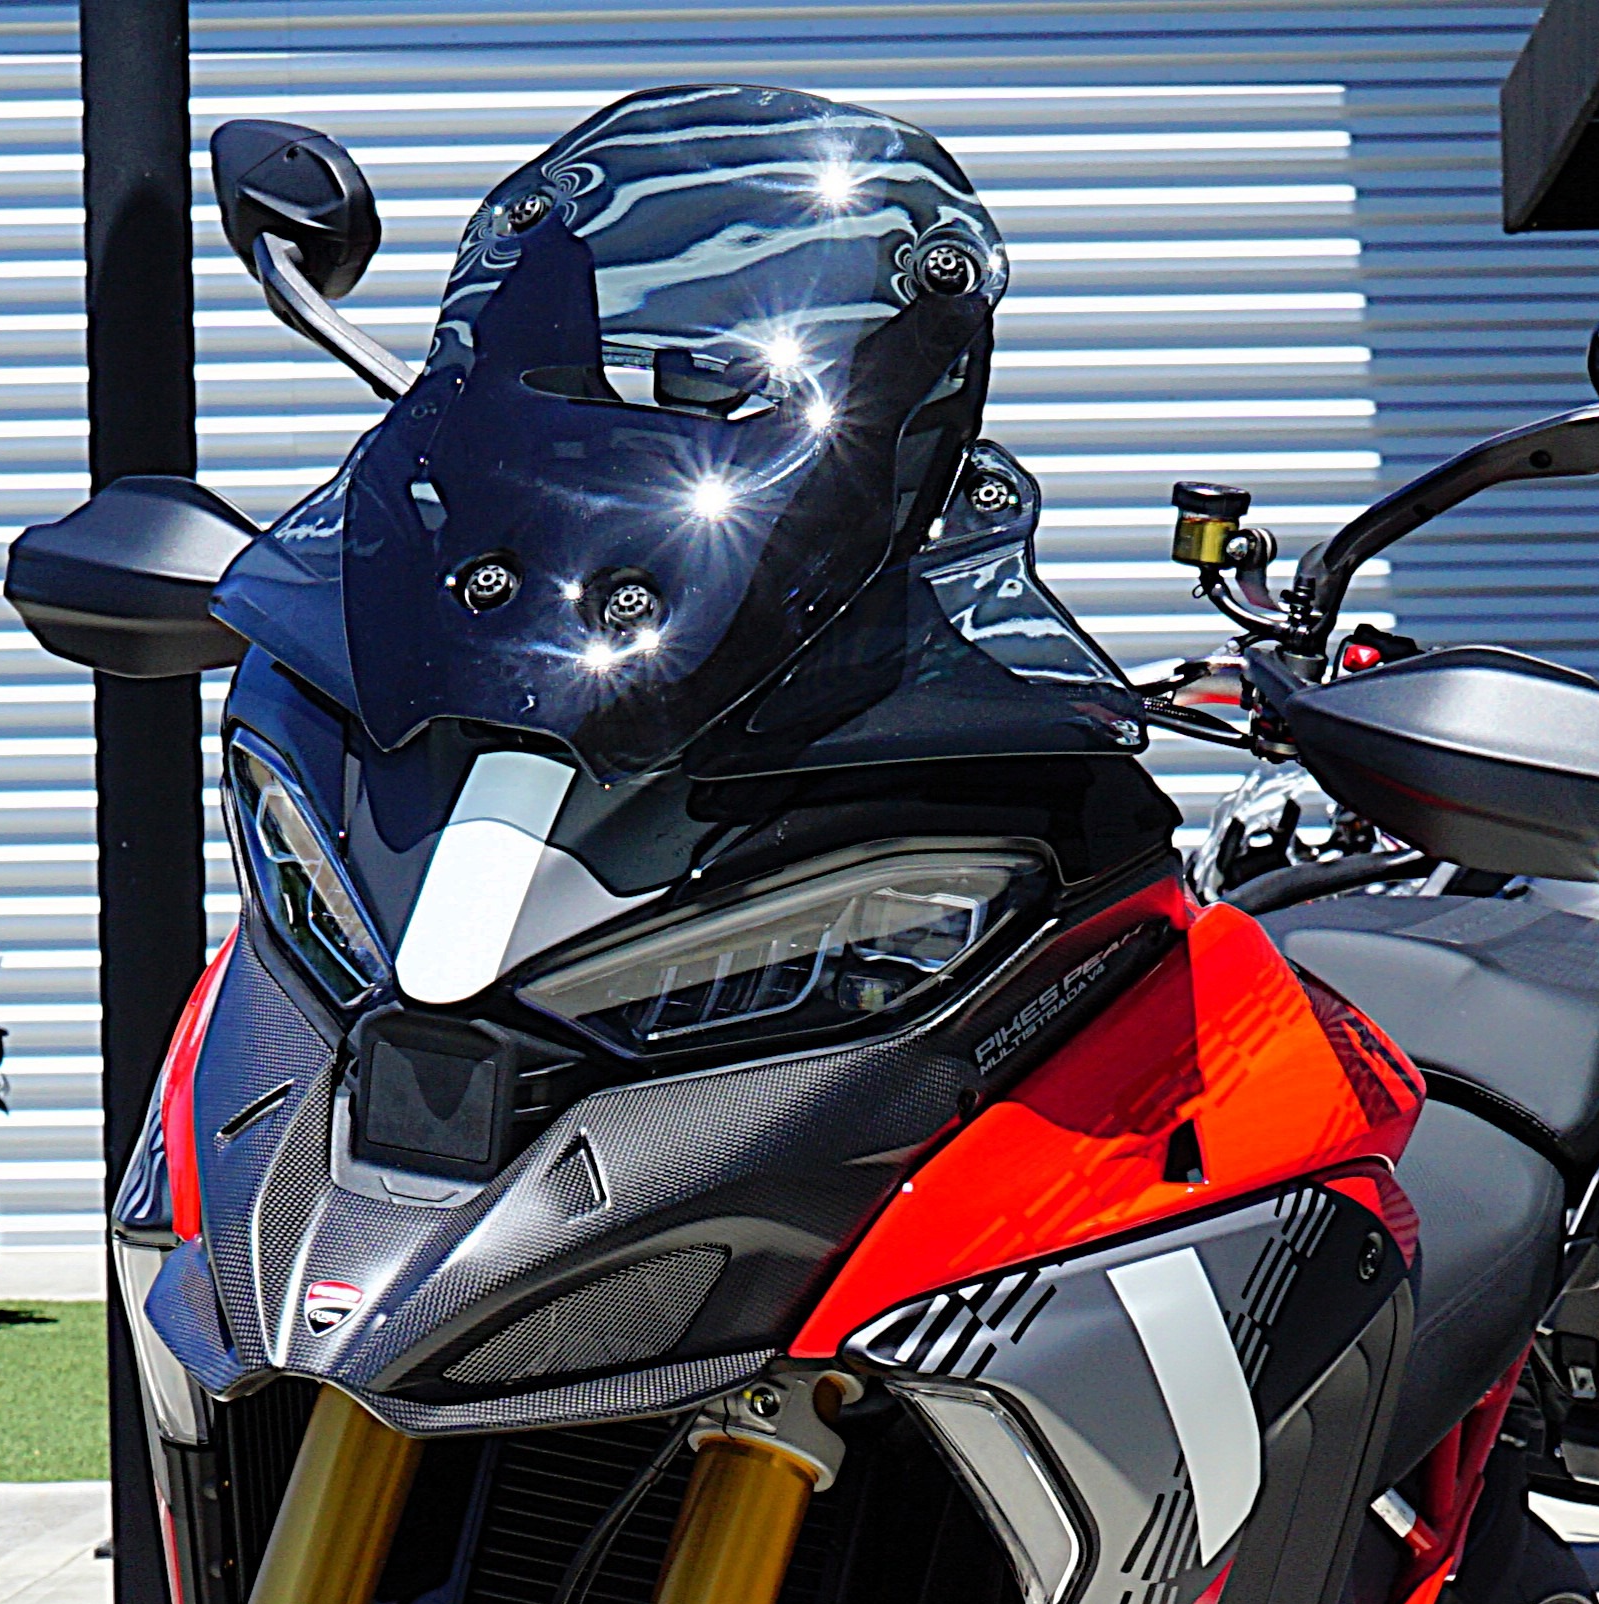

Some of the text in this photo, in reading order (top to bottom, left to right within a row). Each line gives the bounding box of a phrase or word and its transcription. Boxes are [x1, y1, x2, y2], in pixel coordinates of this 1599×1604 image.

[974, 983, 1059, 1063] PIKES
[979, 963, 1106, 1076] MULTISTRADA V4
